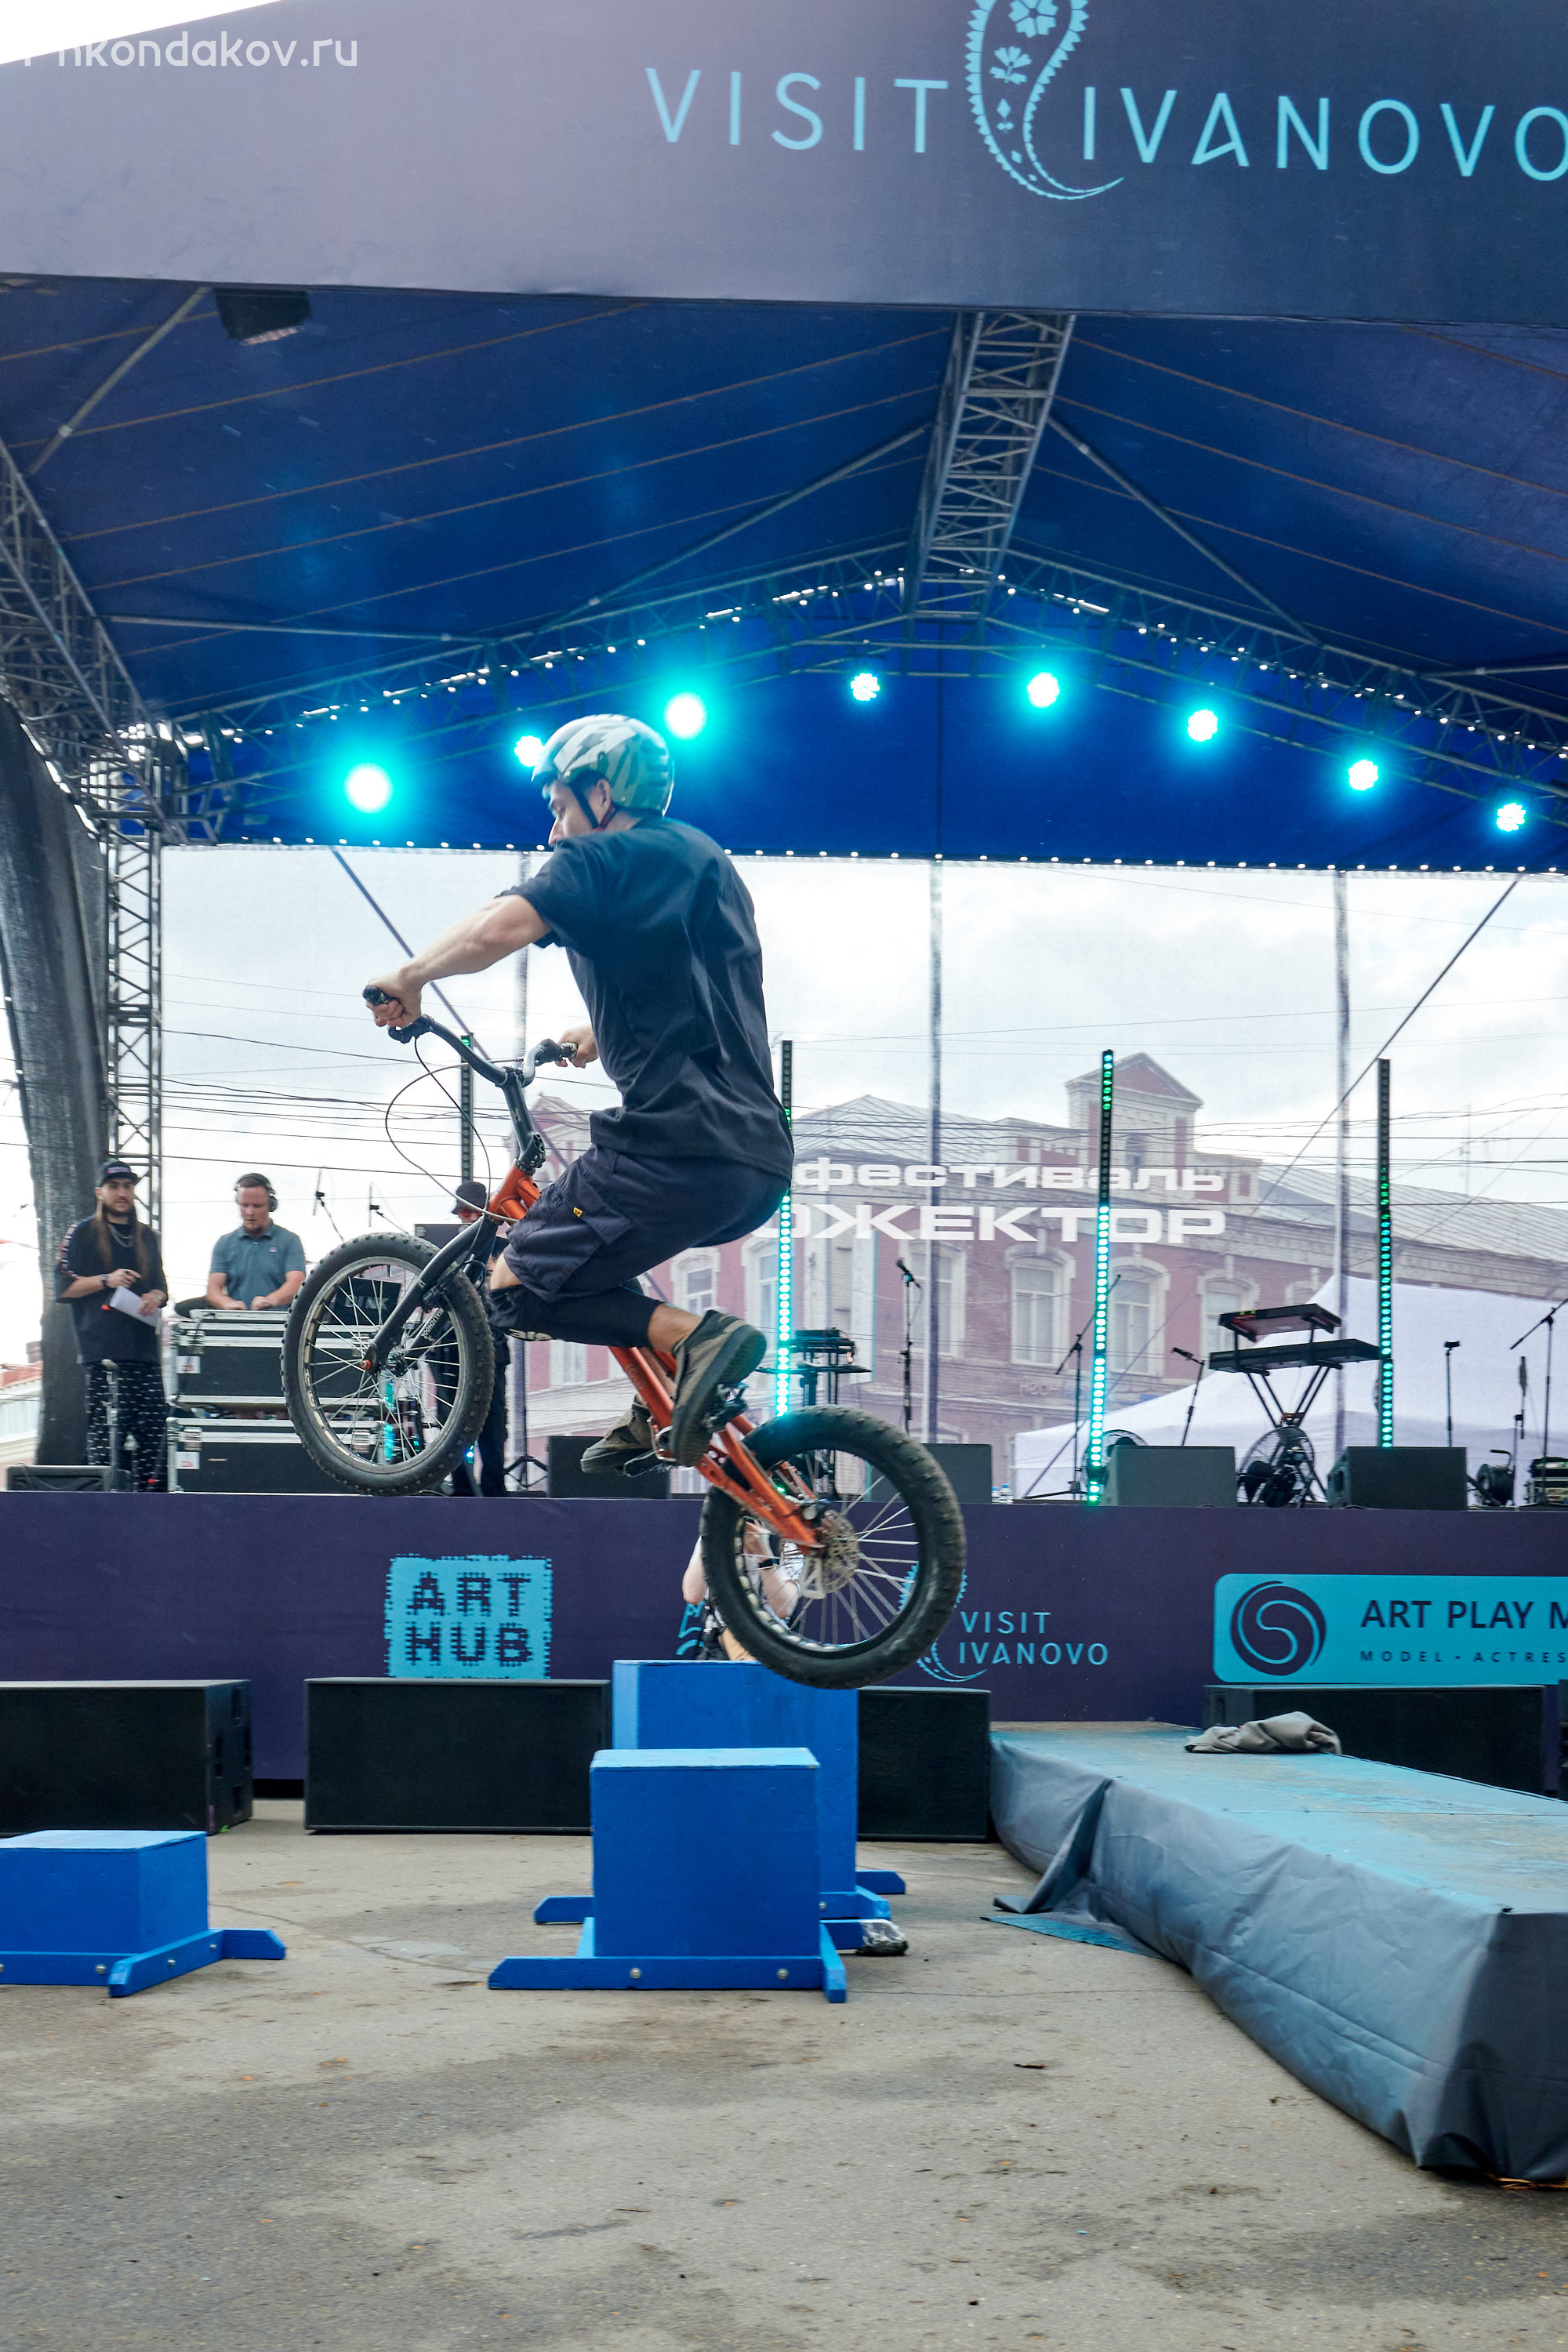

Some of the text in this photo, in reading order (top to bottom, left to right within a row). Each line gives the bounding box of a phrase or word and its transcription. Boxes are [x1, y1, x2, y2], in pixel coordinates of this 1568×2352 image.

[646, 68, 1568, 182] VISIT IVANOVO
[794, 1157, 1225, 1192] фестиваль
[407, 1571, 532, 1617] ART
[960, 1610, 1051, 1635] VISIT
[1360, 1599, 1432, 1628] ART
[1447, 1600, 1534, 1629] PLAY
[406, 1622, 533, 1667] HUB
[959, 1642, 1109, 1666] IVANOVO
[1360, 1650, 1443, 1662] MODEL
